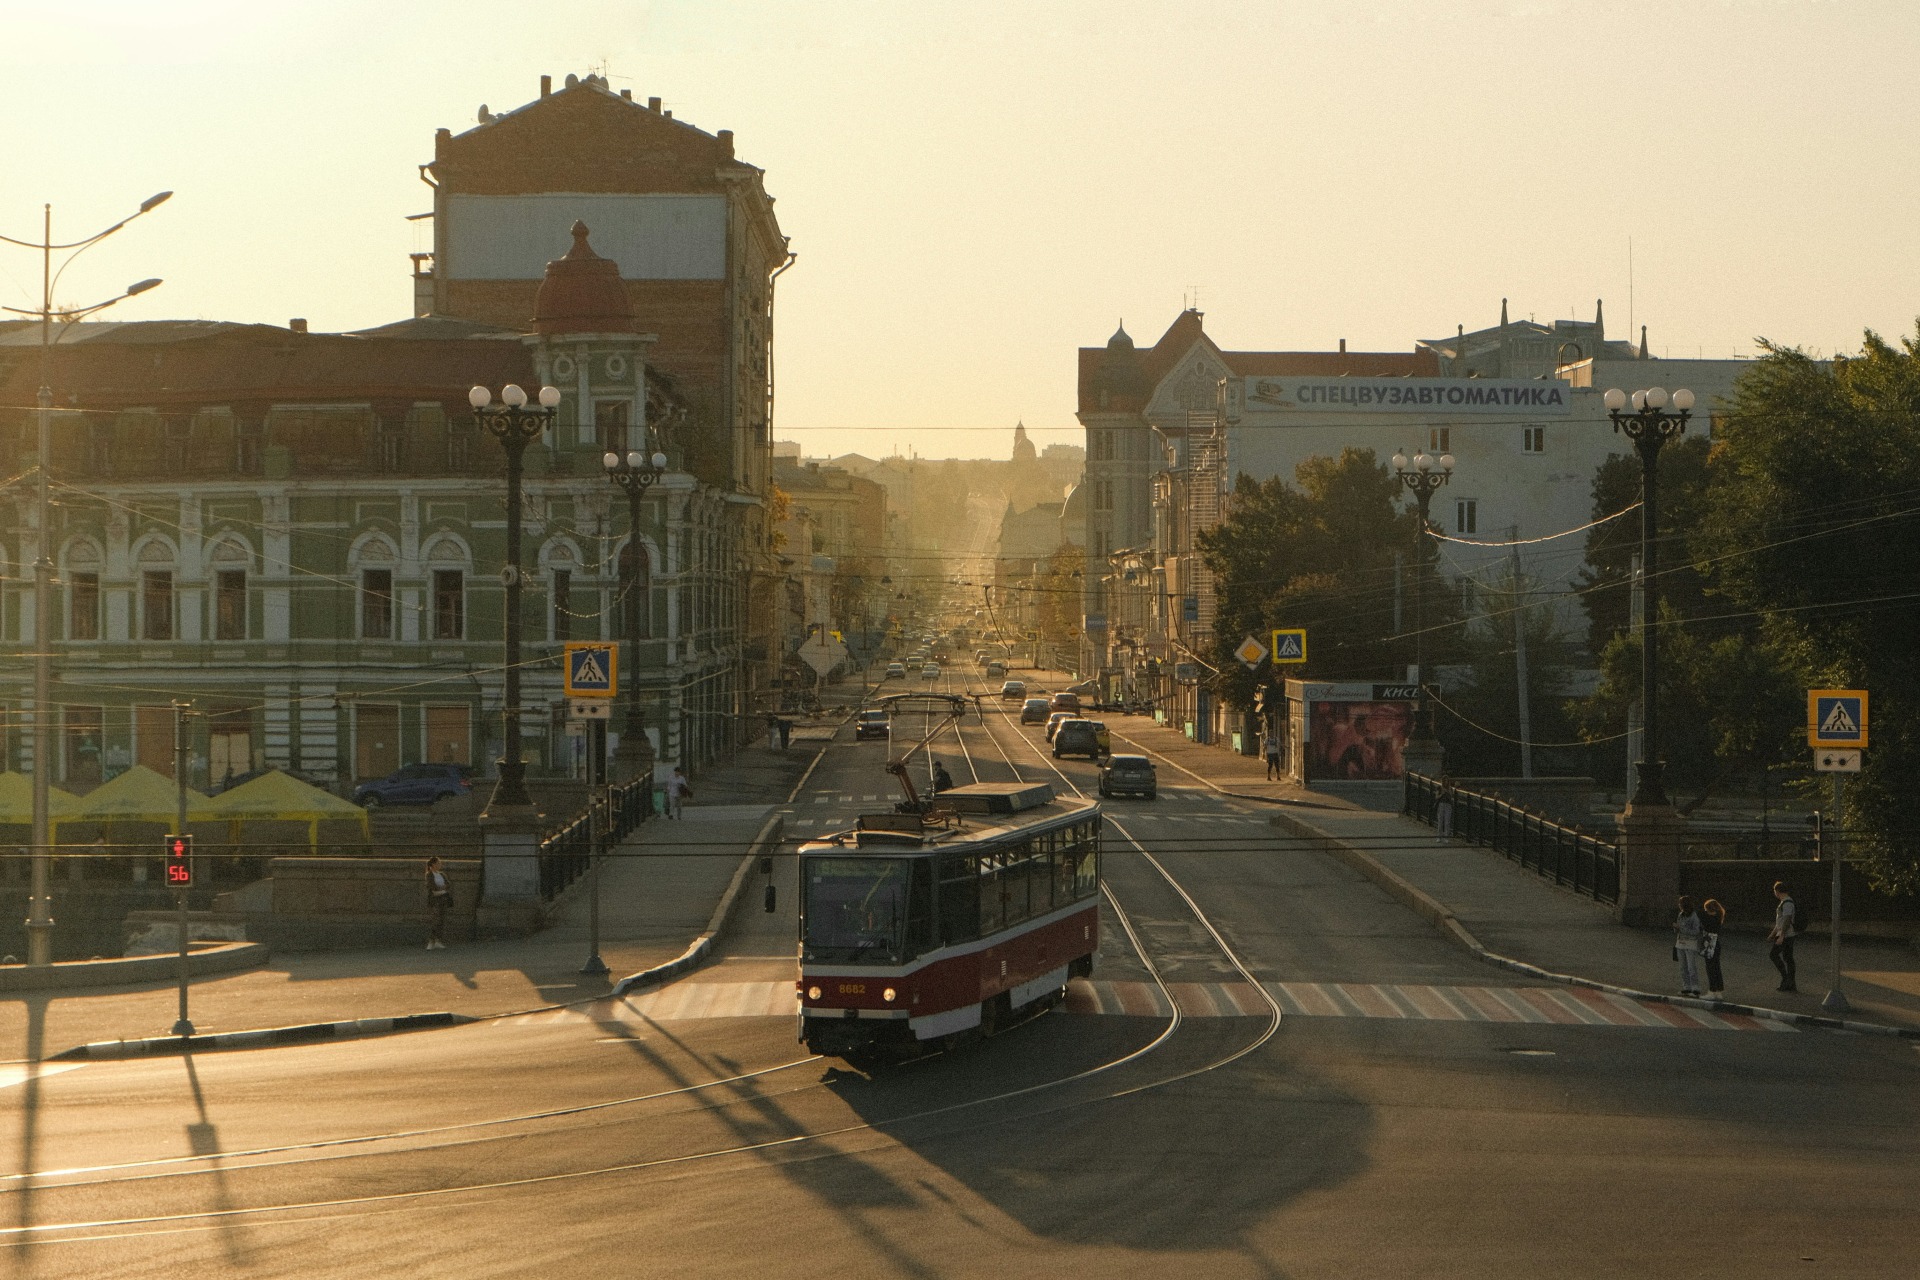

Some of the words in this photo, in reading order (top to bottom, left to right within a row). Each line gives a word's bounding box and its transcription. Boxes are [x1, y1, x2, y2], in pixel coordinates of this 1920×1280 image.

[1297, 385, 1563, 406] СПЕЦВУЗАВТОМАТИКА
[1382, 688, 1419, 698] КИСЕ
[169, 866, 189, 881] 56
[839, 984, 866, 994] 8682
